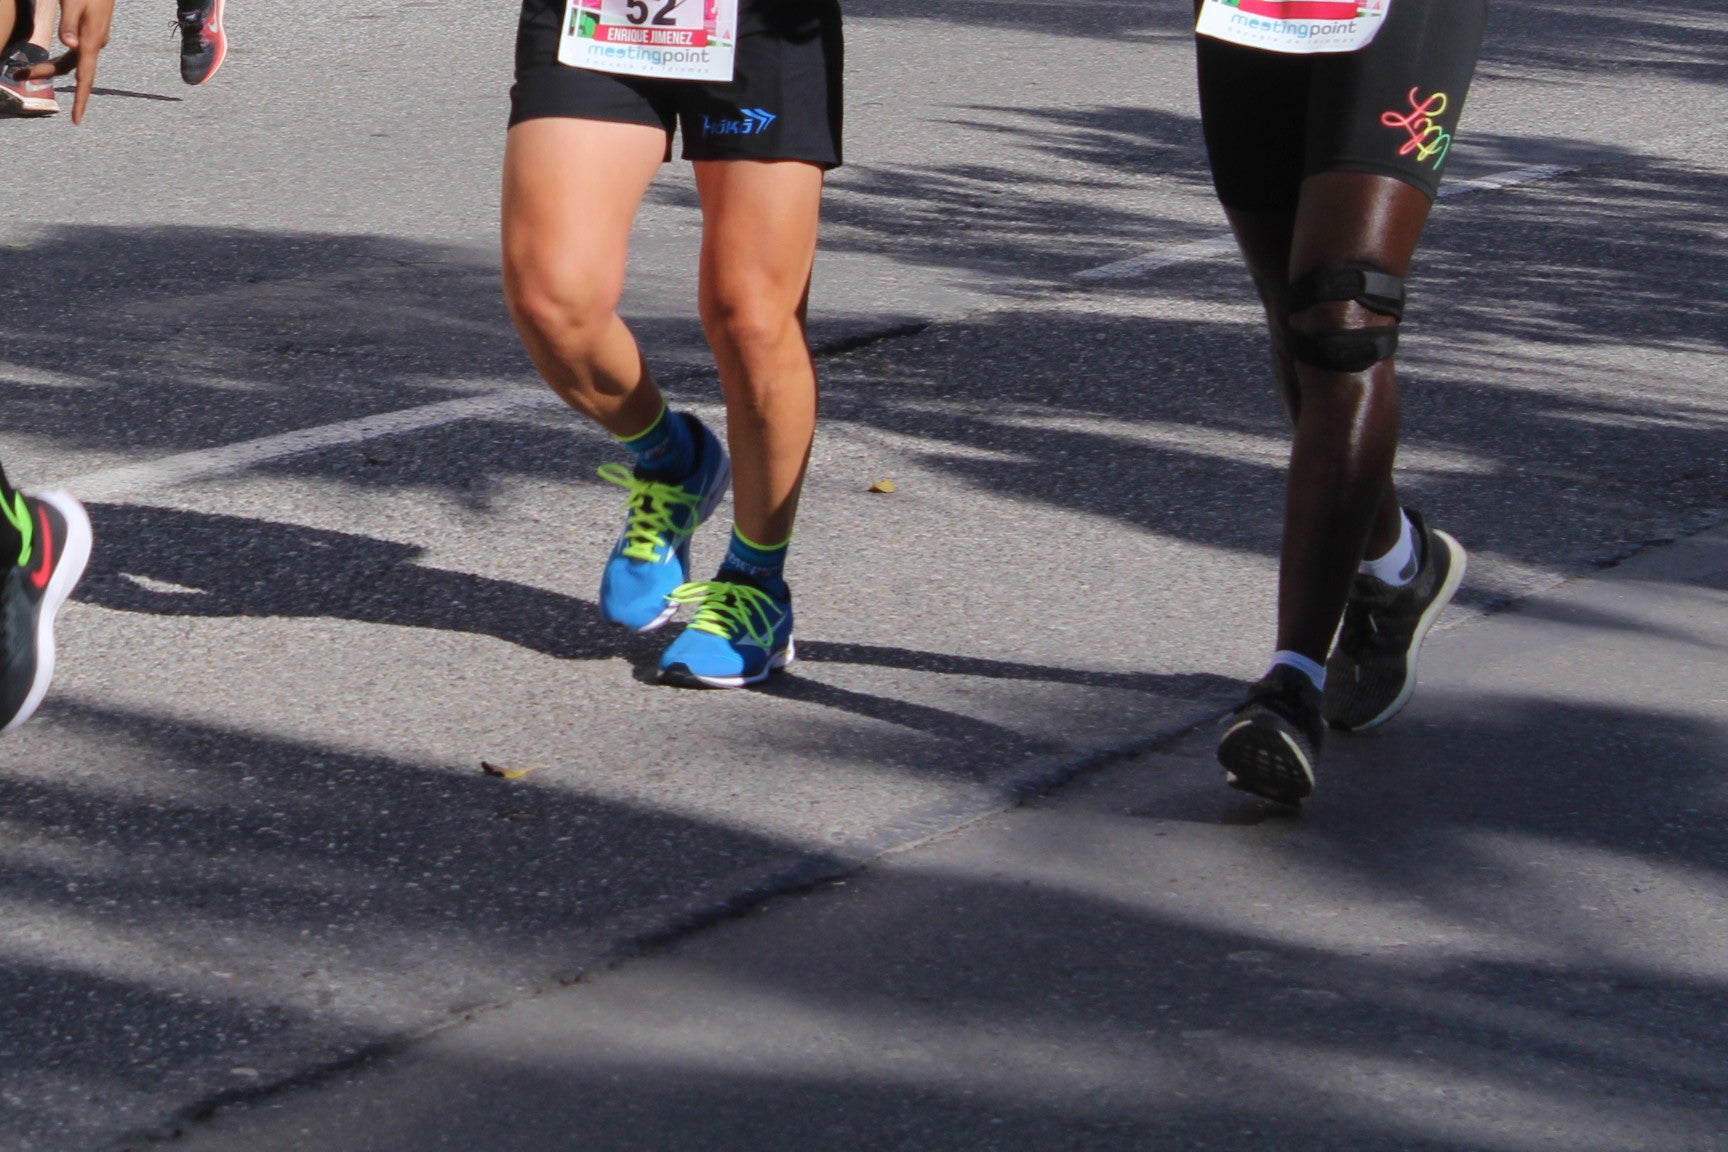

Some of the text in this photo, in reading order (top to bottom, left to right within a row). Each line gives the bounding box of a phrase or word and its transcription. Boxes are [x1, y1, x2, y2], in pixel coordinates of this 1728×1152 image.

[1231, 14, 1357, 38] meetingpoint
[607, 28, 693, 45] ENRIQUE JIMENEZ
[588, 45, 710, 65] meetingpoint
